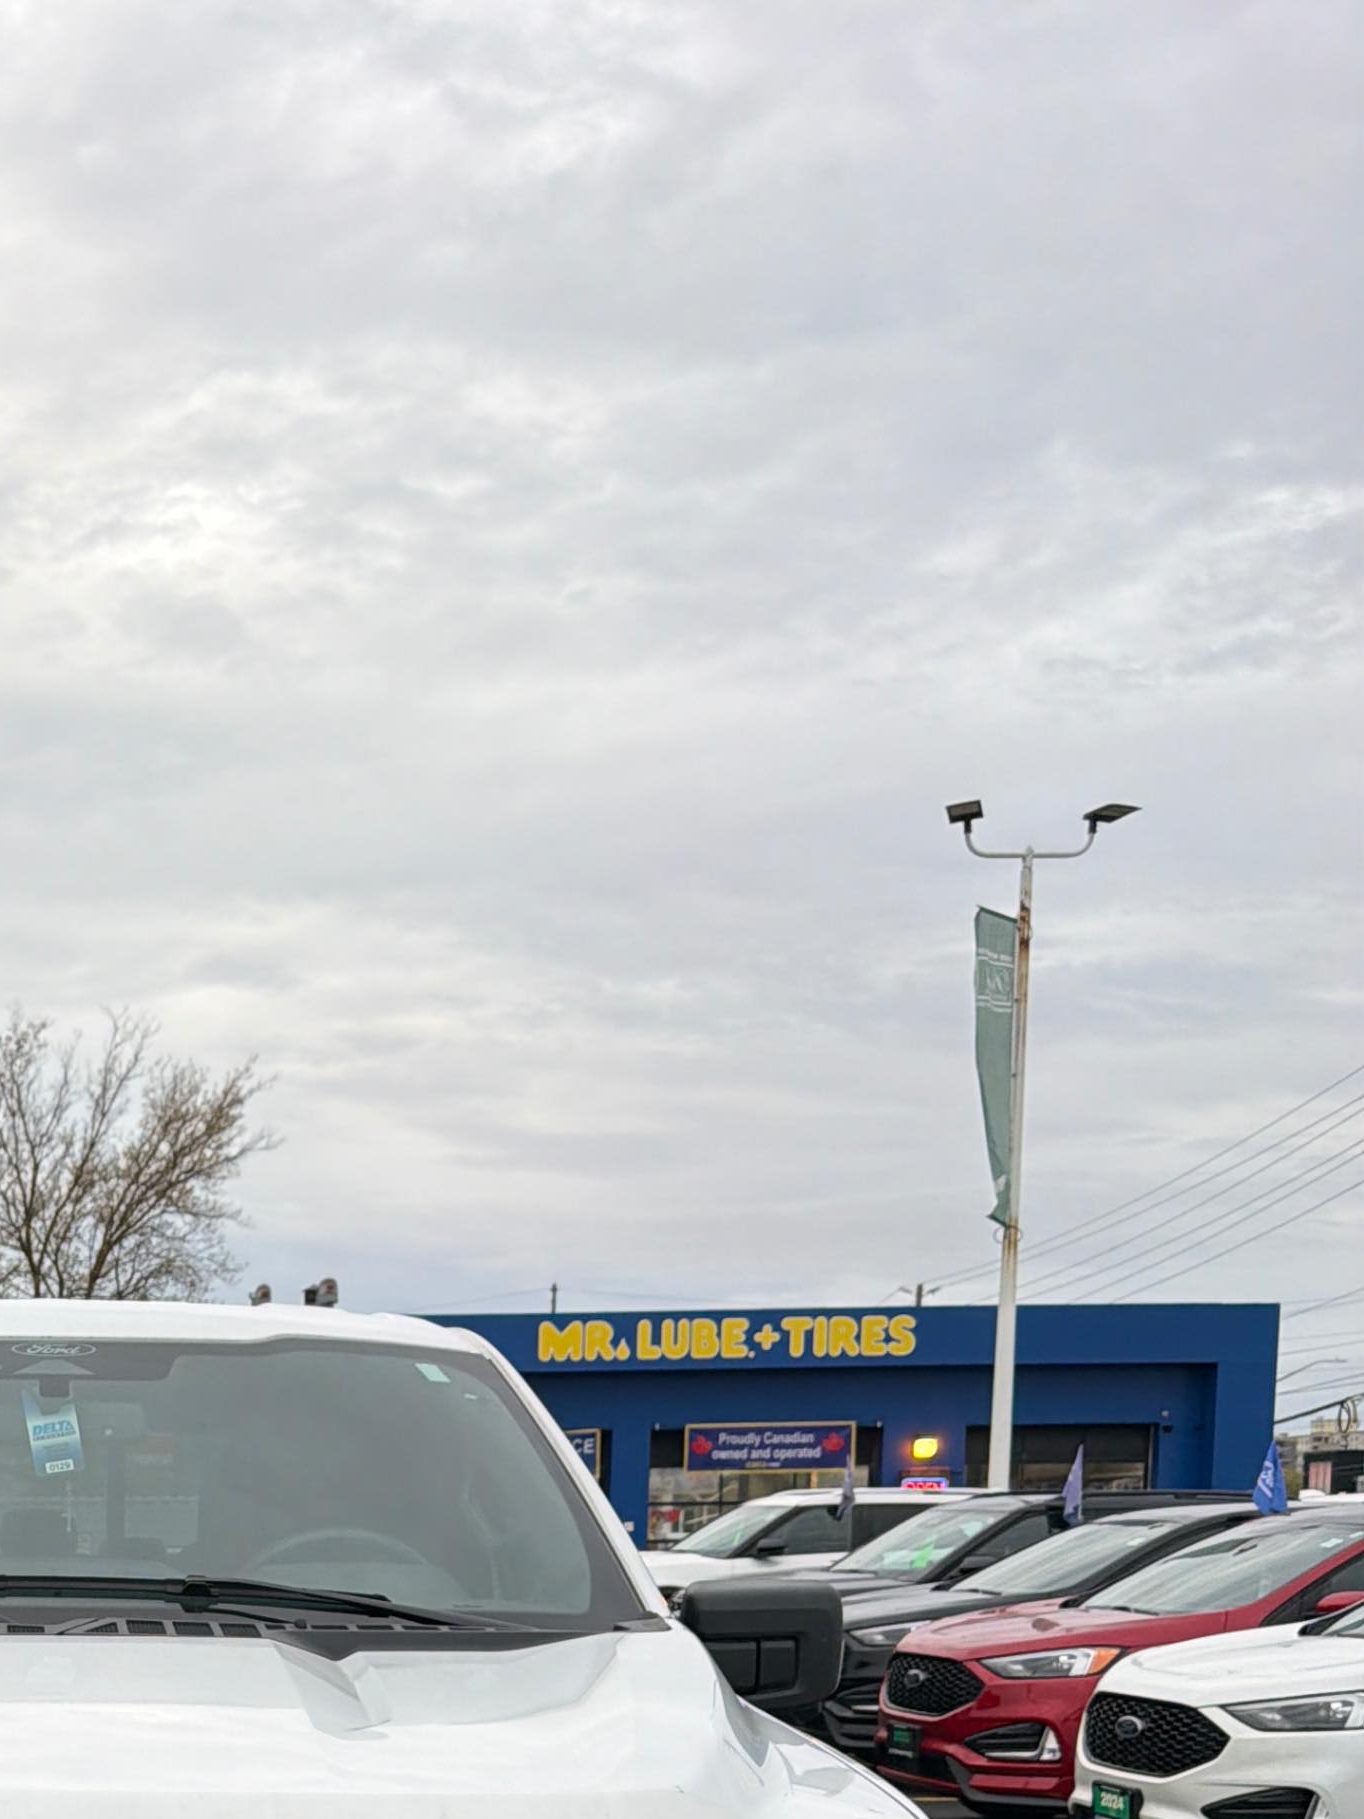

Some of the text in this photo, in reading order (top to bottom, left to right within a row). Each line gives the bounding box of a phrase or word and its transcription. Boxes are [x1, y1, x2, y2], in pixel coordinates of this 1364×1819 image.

[780, 1314, 917, 1358] TIRES
[32, 1419, 76, 1436] DELTA
[718, 1431, 815, 1446] Proudly Canadian
[711, 1446, 822, 1461] owned and operated
[48, 1460, 71, 1472] 0129
[1100, 1791, 1125, 1811] 2024
